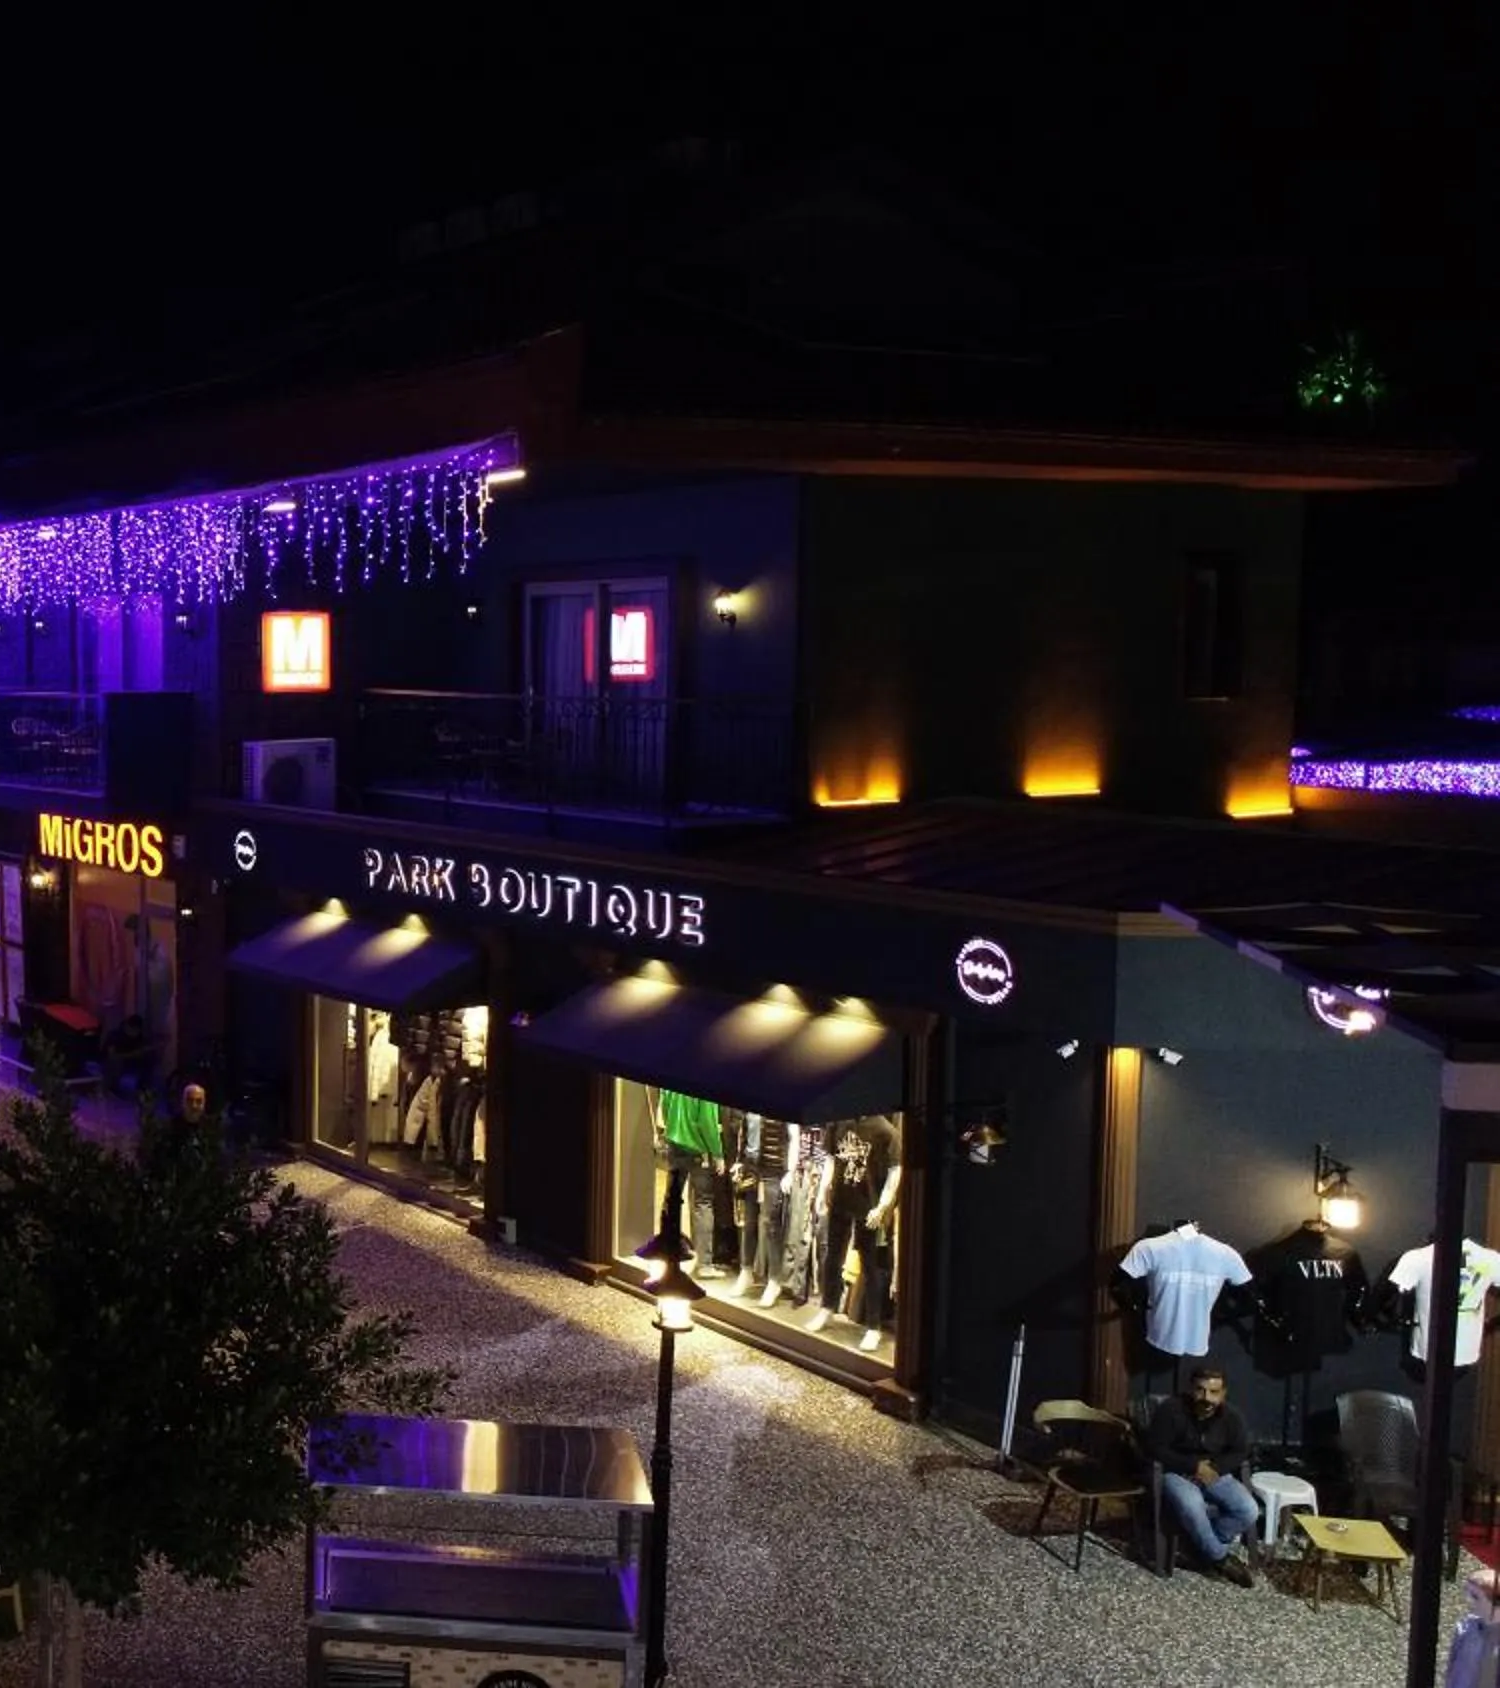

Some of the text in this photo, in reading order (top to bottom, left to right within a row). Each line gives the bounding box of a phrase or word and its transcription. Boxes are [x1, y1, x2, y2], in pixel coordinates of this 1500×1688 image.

[271, 616, 324, 671] M
[364, 847, 705, 946] PARK BOUTIQUE
